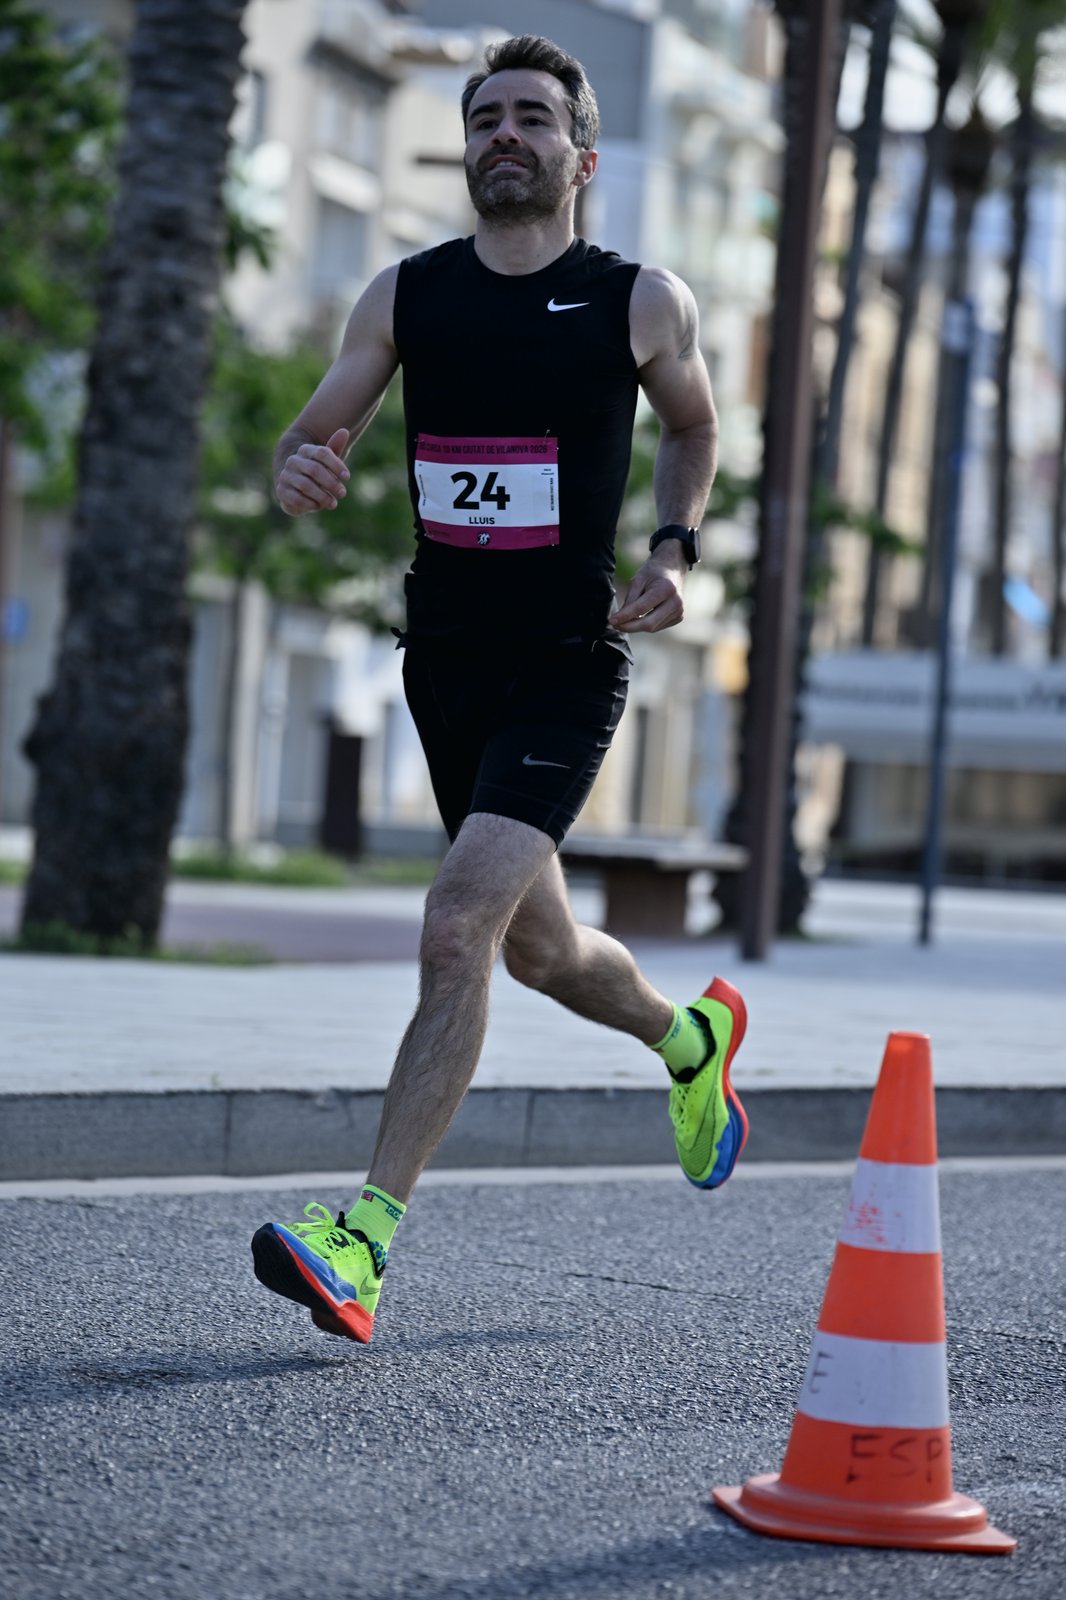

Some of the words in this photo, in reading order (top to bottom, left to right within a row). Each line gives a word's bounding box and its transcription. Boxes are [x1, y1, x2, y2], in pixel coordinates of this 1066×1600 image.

[451, 445, 462, 454] KM
[463, 445, 485, 454] CIUTAT
[487, 445, 495, 454] DE
[496, 445, 528, 454] VILANOVA
[450, 471, 511, 510] 24
[469, 517, 495, 525] LLUIS
